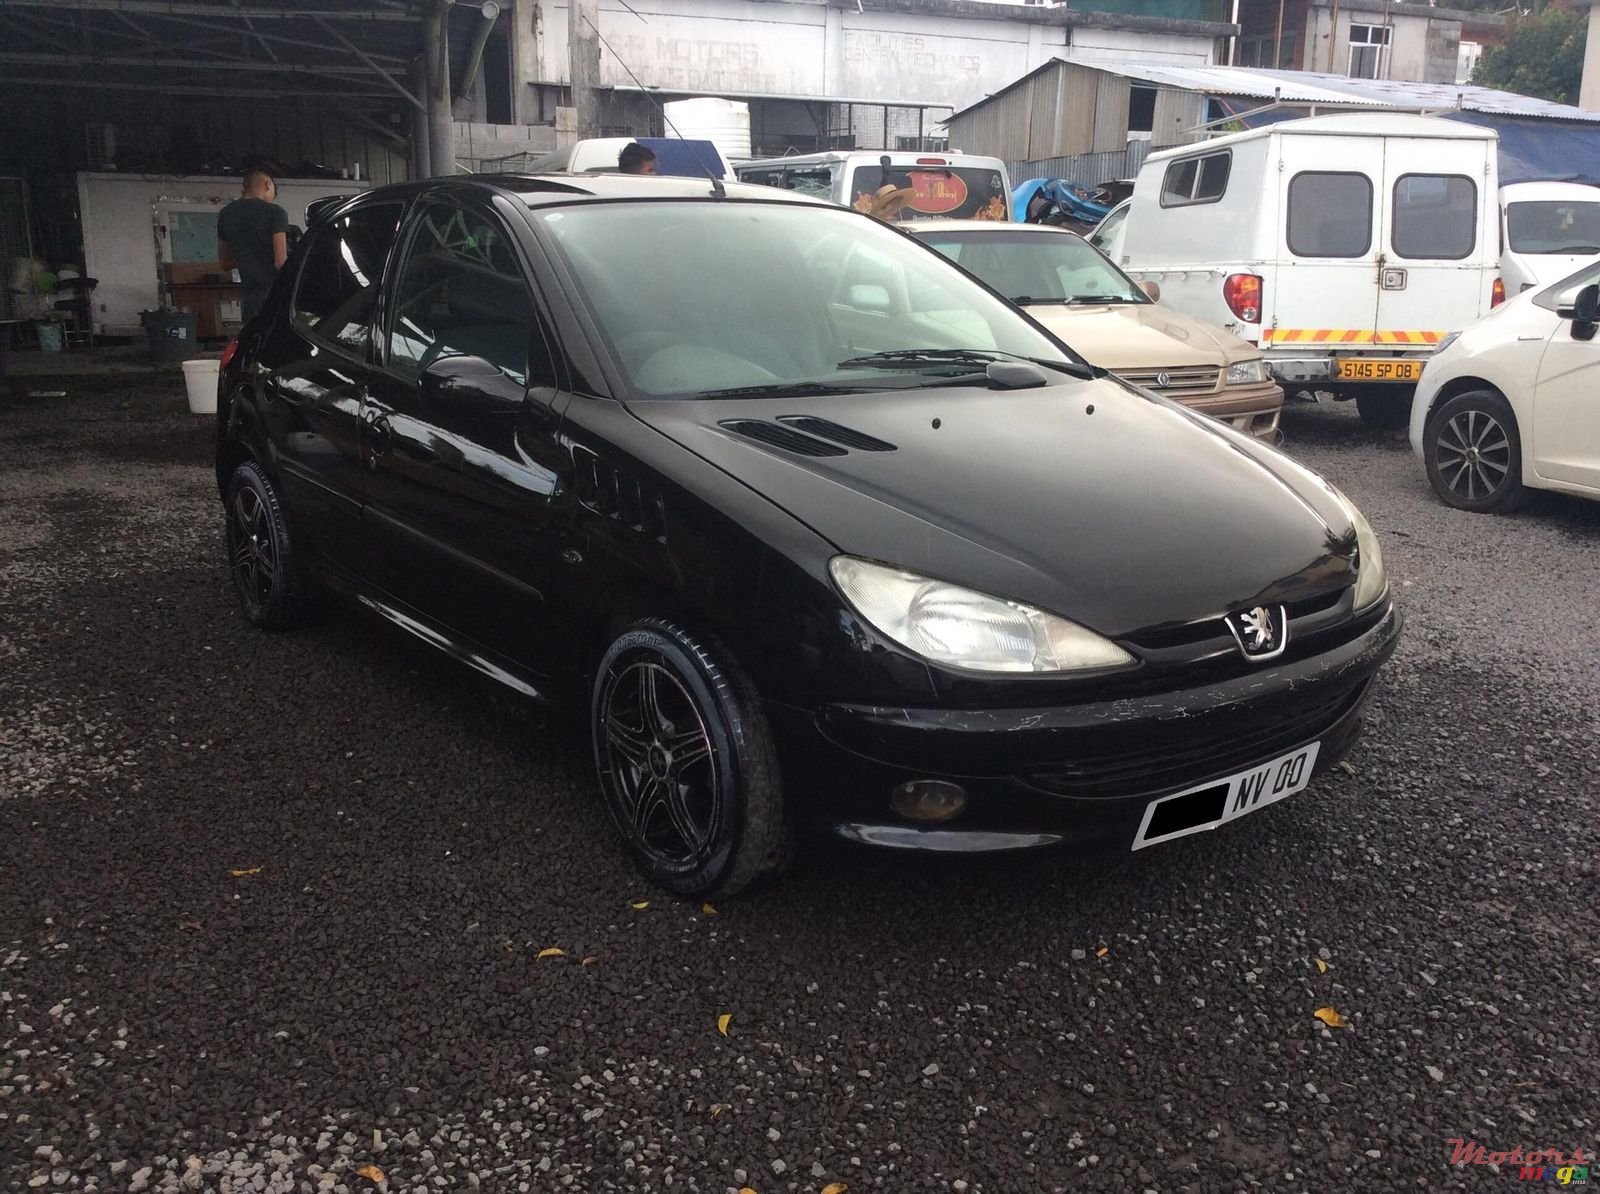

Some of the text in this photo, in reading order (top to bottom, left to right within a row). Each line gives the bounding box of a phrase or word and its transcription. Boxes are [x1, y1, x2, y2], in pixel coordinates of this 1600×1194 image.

[655, 37, 761, 66] MOTORS
[1344, 363, 1412, 377] 5145 SP 08
[1231, 767, 1271, 813] NV
